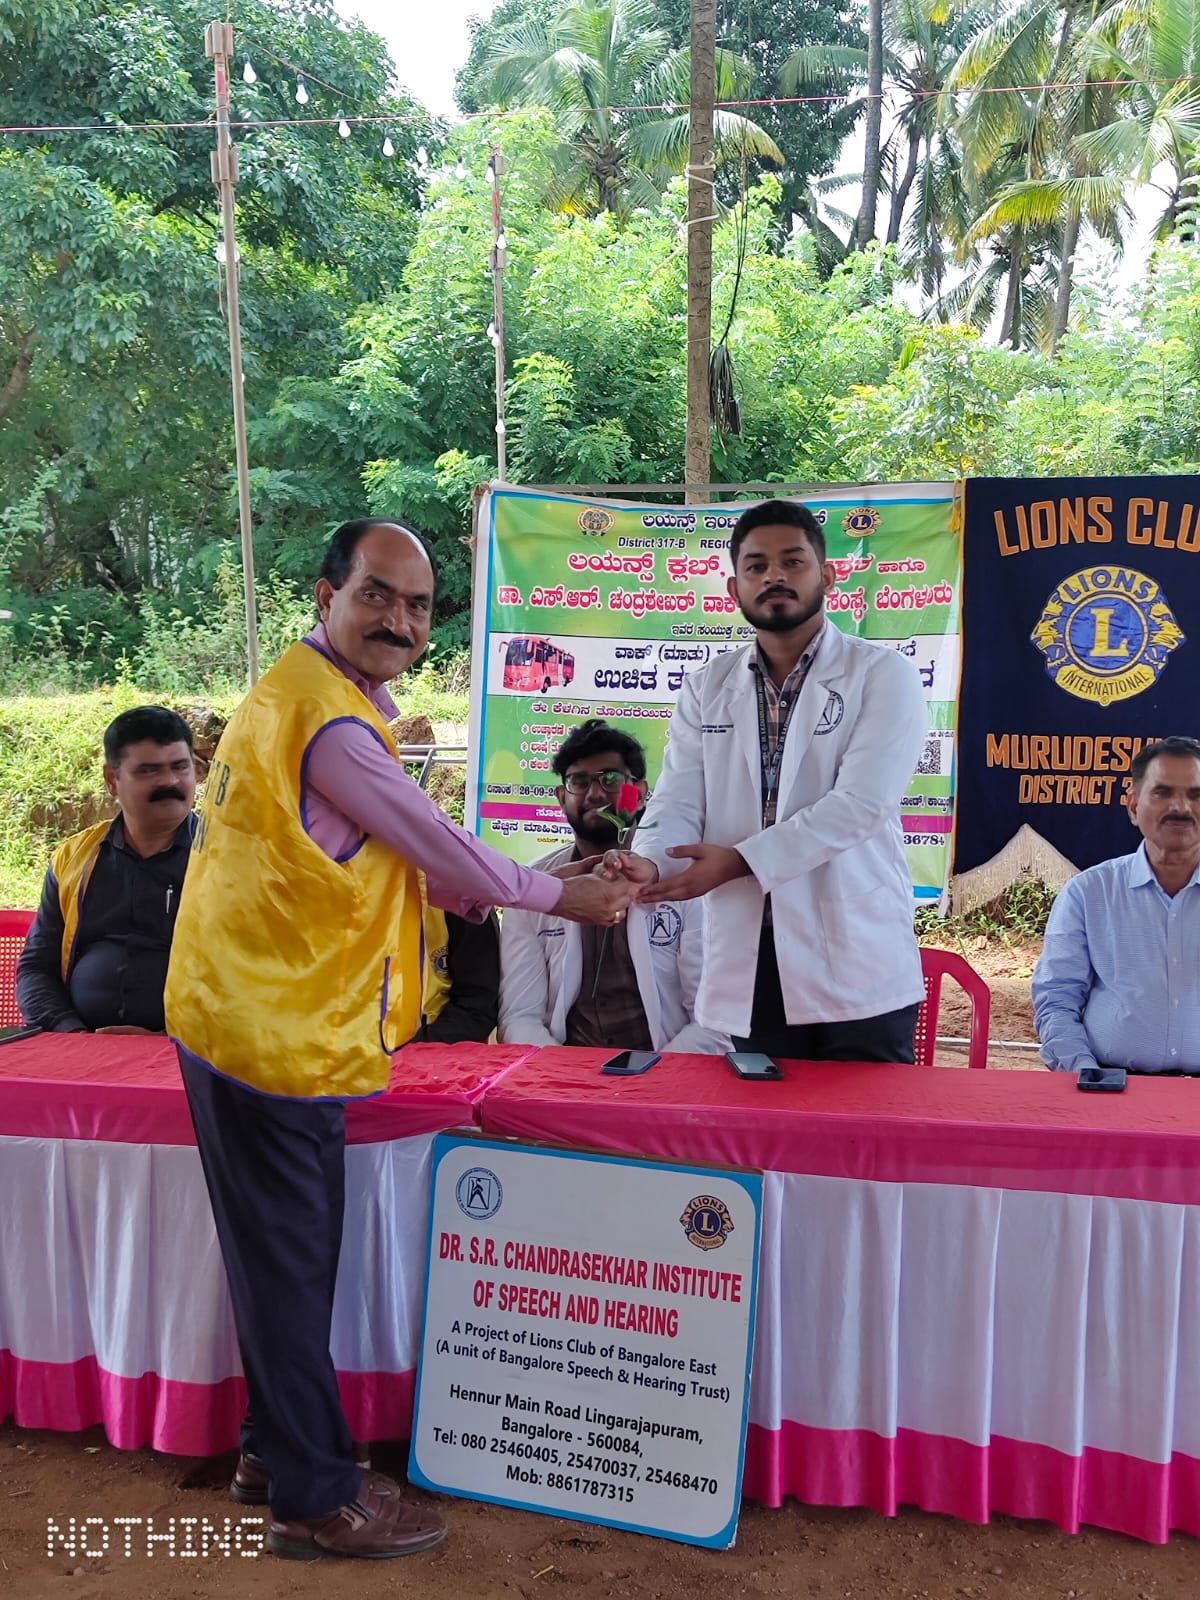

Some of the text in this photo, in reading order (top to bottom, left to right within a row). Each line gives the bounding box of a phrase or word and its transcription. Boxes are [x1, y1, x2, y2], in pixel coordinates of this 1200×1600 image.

[618, 537, 655, 548] District
[657, 538, 686, 549] 317-B
[993, 496, 1200, 557] LIONS CLU
[1062, 568, 1153, 600] LIONS
[1089, 608, 1130, 657] L
[1062, 669, 1150, 696] INTERNATIONAL
[986, 733, 1163, 772] MURUDES
[1018, 775, 1117, 805] DISTRICT
[692, 1197, 724, 1212] LIONS
[700, 1212, 715, 1232] L
[439, 1232, 743, 1303] DR. S.R. CHANDRASEKHAR INSTITUTE
[473, 1279, 679, 1338] OF SPEECH AND HEARING
[451, 1320, 717, 1376] A Project of Lions Club of Bangalore East
[436, 1339, 730, 1402] (A unit of Bangalore Speech & Hearing Trust)
[449, 1383, 703, 1445] Hennur Main Road Lingarajapuram,
[501, 1416, 573, 1442] Bangalore
[587, 1431, 643, 1458] 560084,
[433, 1427, 718, 1495] Tel: 080 25460405, 25470037, 25468470
[506, 1464, 634, 1503] Mob: 8861787315
